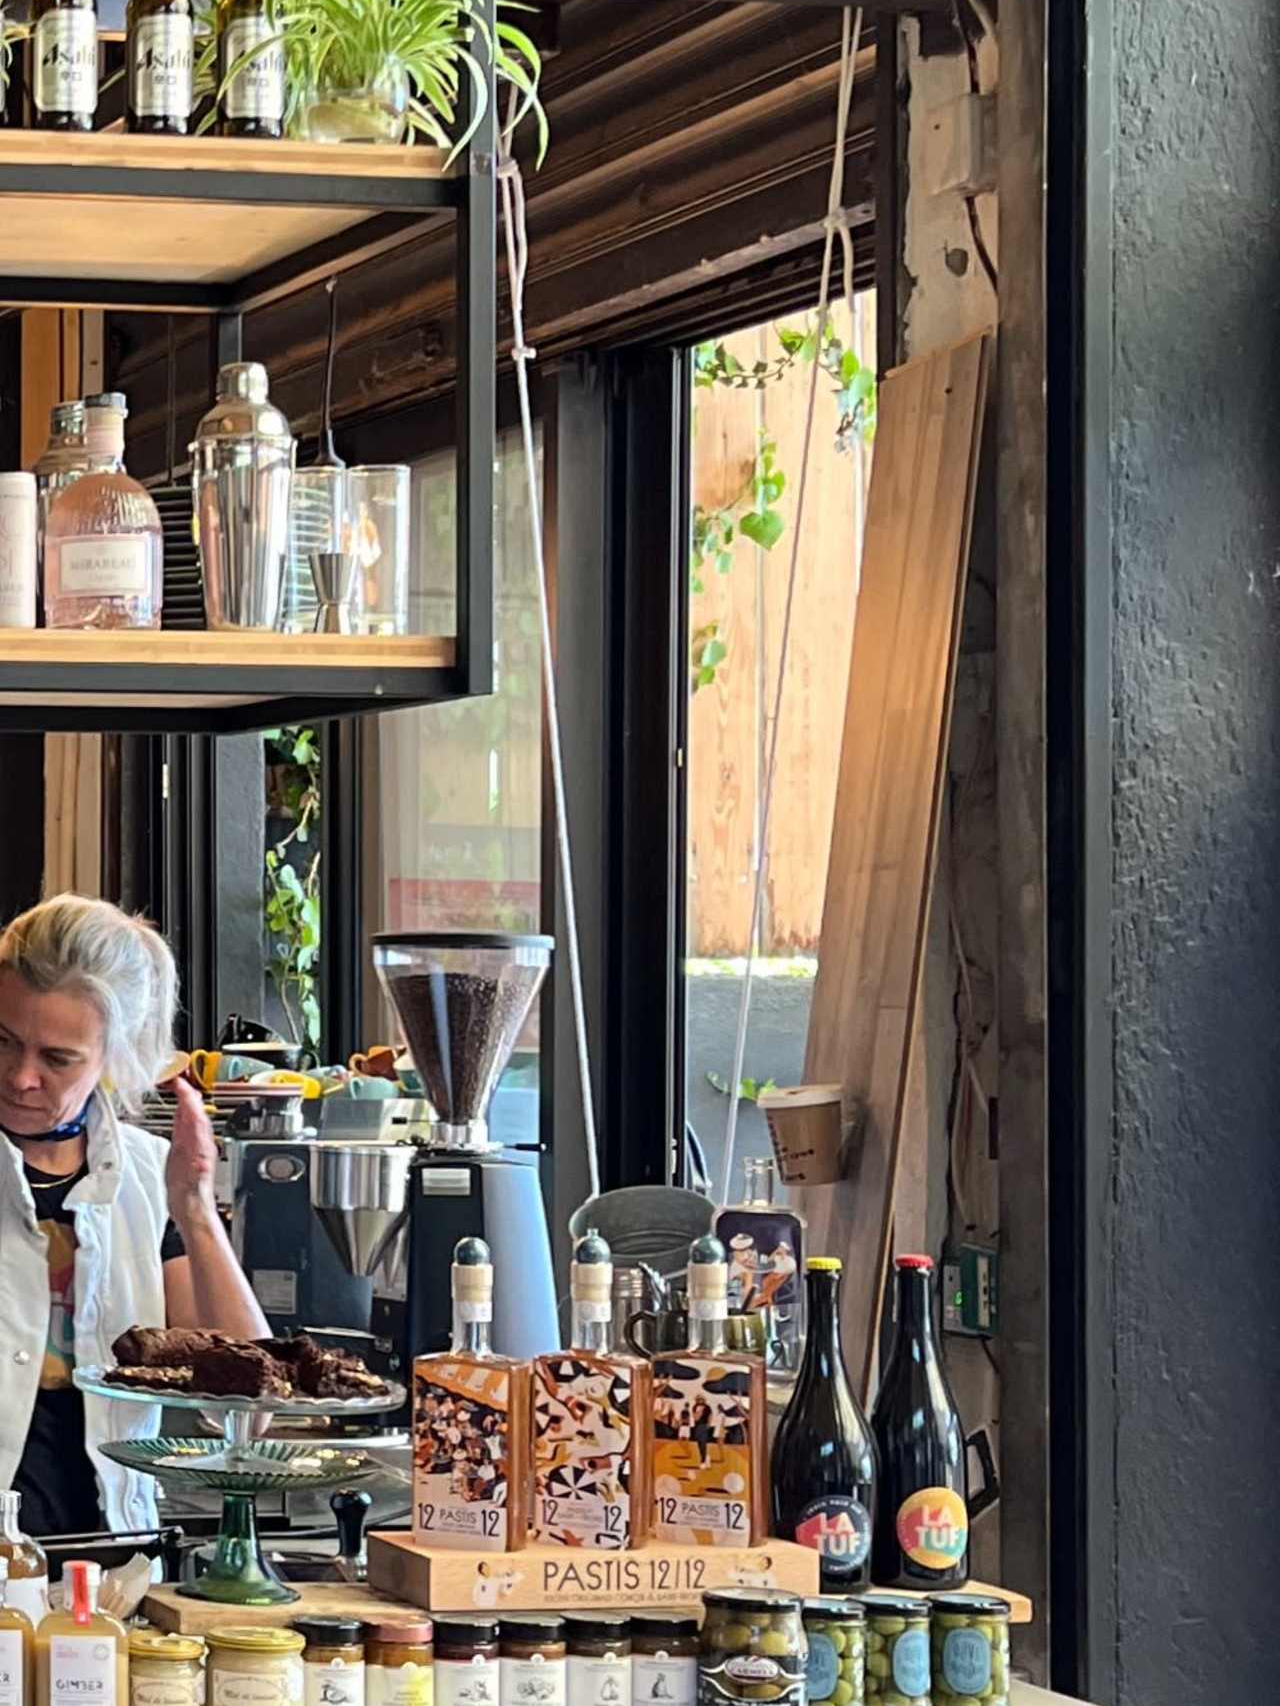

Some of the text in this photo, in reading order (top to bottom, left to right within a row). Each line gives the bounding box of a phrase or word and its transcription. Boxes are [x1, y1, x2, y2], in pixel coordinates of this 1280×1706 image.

[417, 1502, 500, 1537] 12 PASTIS 12
[541, 1498, 623, 1532] 12 12
[659, 1497, 678, 1524] 12
[724, 1502, 745, 1530] 12
[819, 1511, 856, 1534] LA
[921, 1503, 955, 1526] LA
[813, 1531, 861, 1556] TUF
[915, 1524, 961, 1550] TUF
[543, 1558, 706, 1592] PASTIS 12/12
